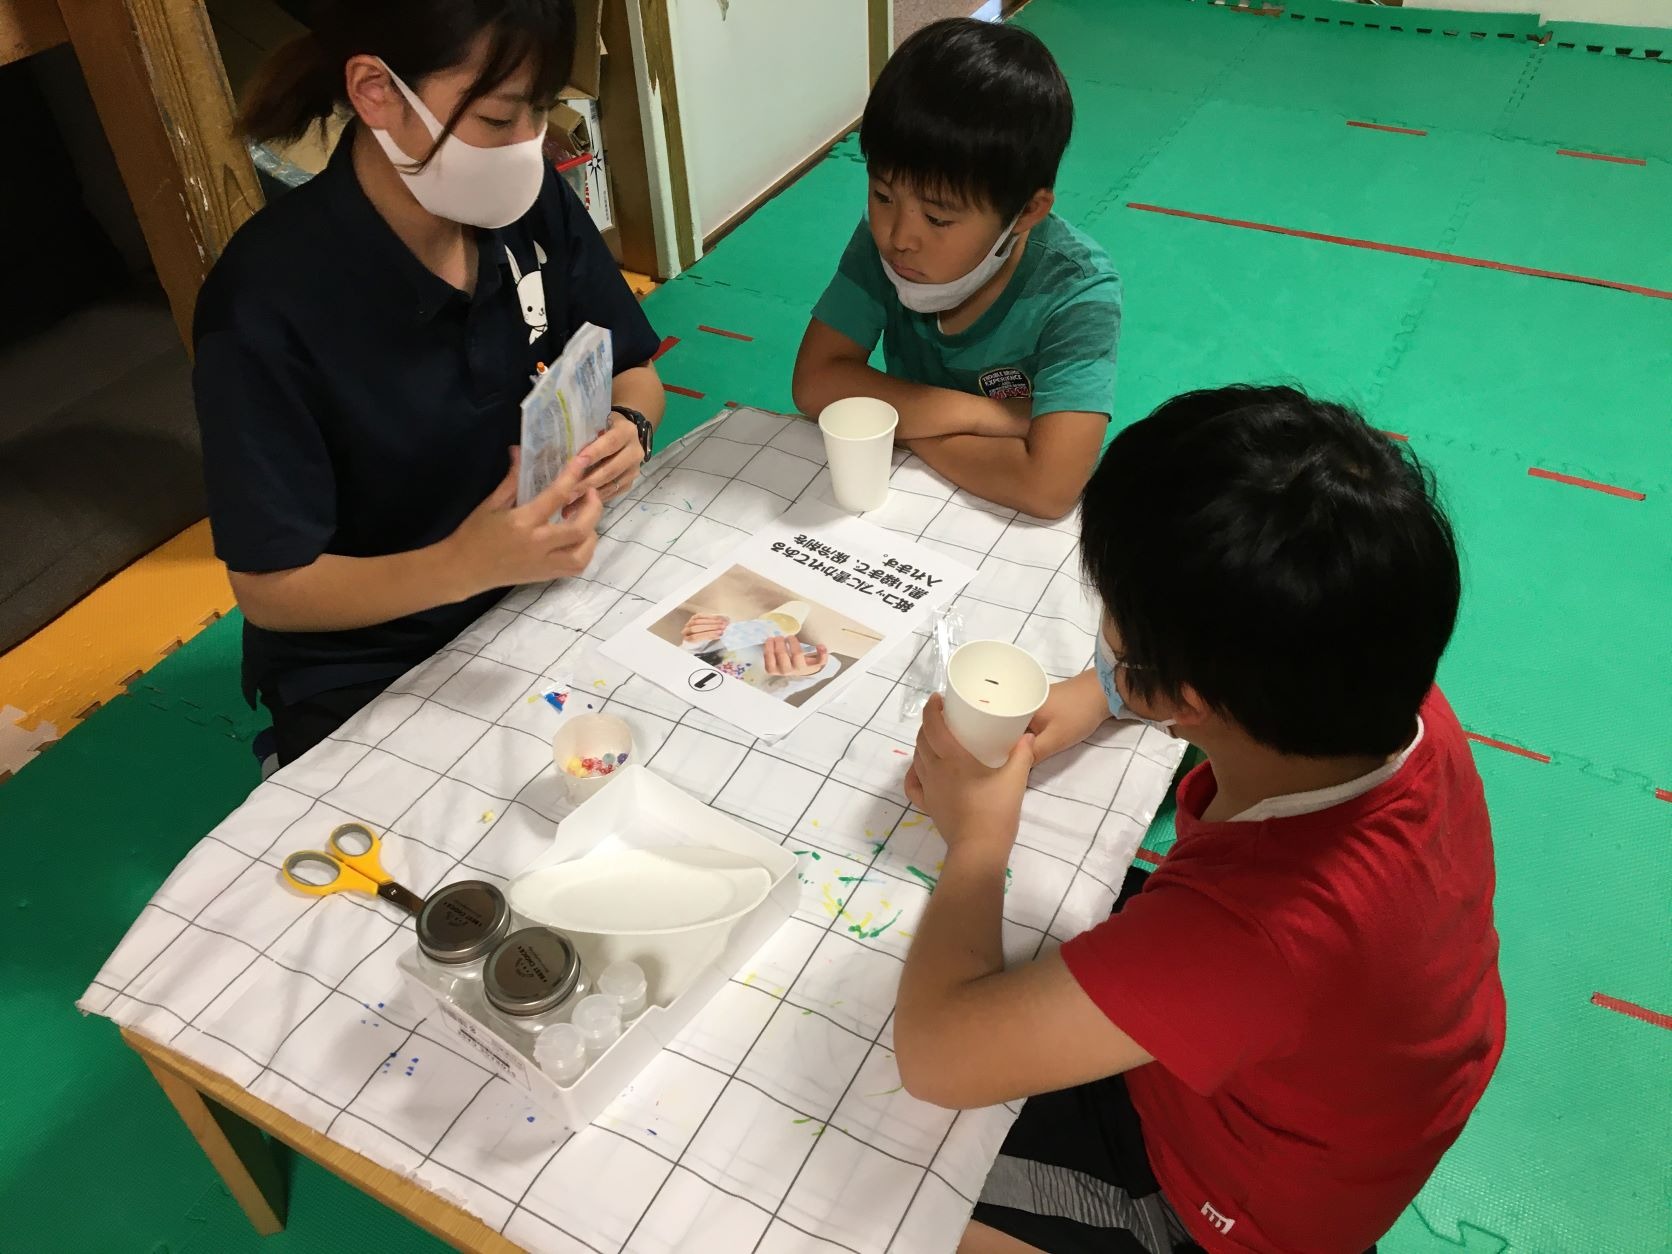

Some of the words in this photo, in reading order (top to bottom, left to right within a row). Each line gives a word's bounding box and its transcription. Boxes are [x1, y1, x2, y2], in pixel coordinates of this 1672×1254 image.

[770, 542, 915, 613] 紙コップに書かれてある
[882, 553, 943, 588] 入れます。
